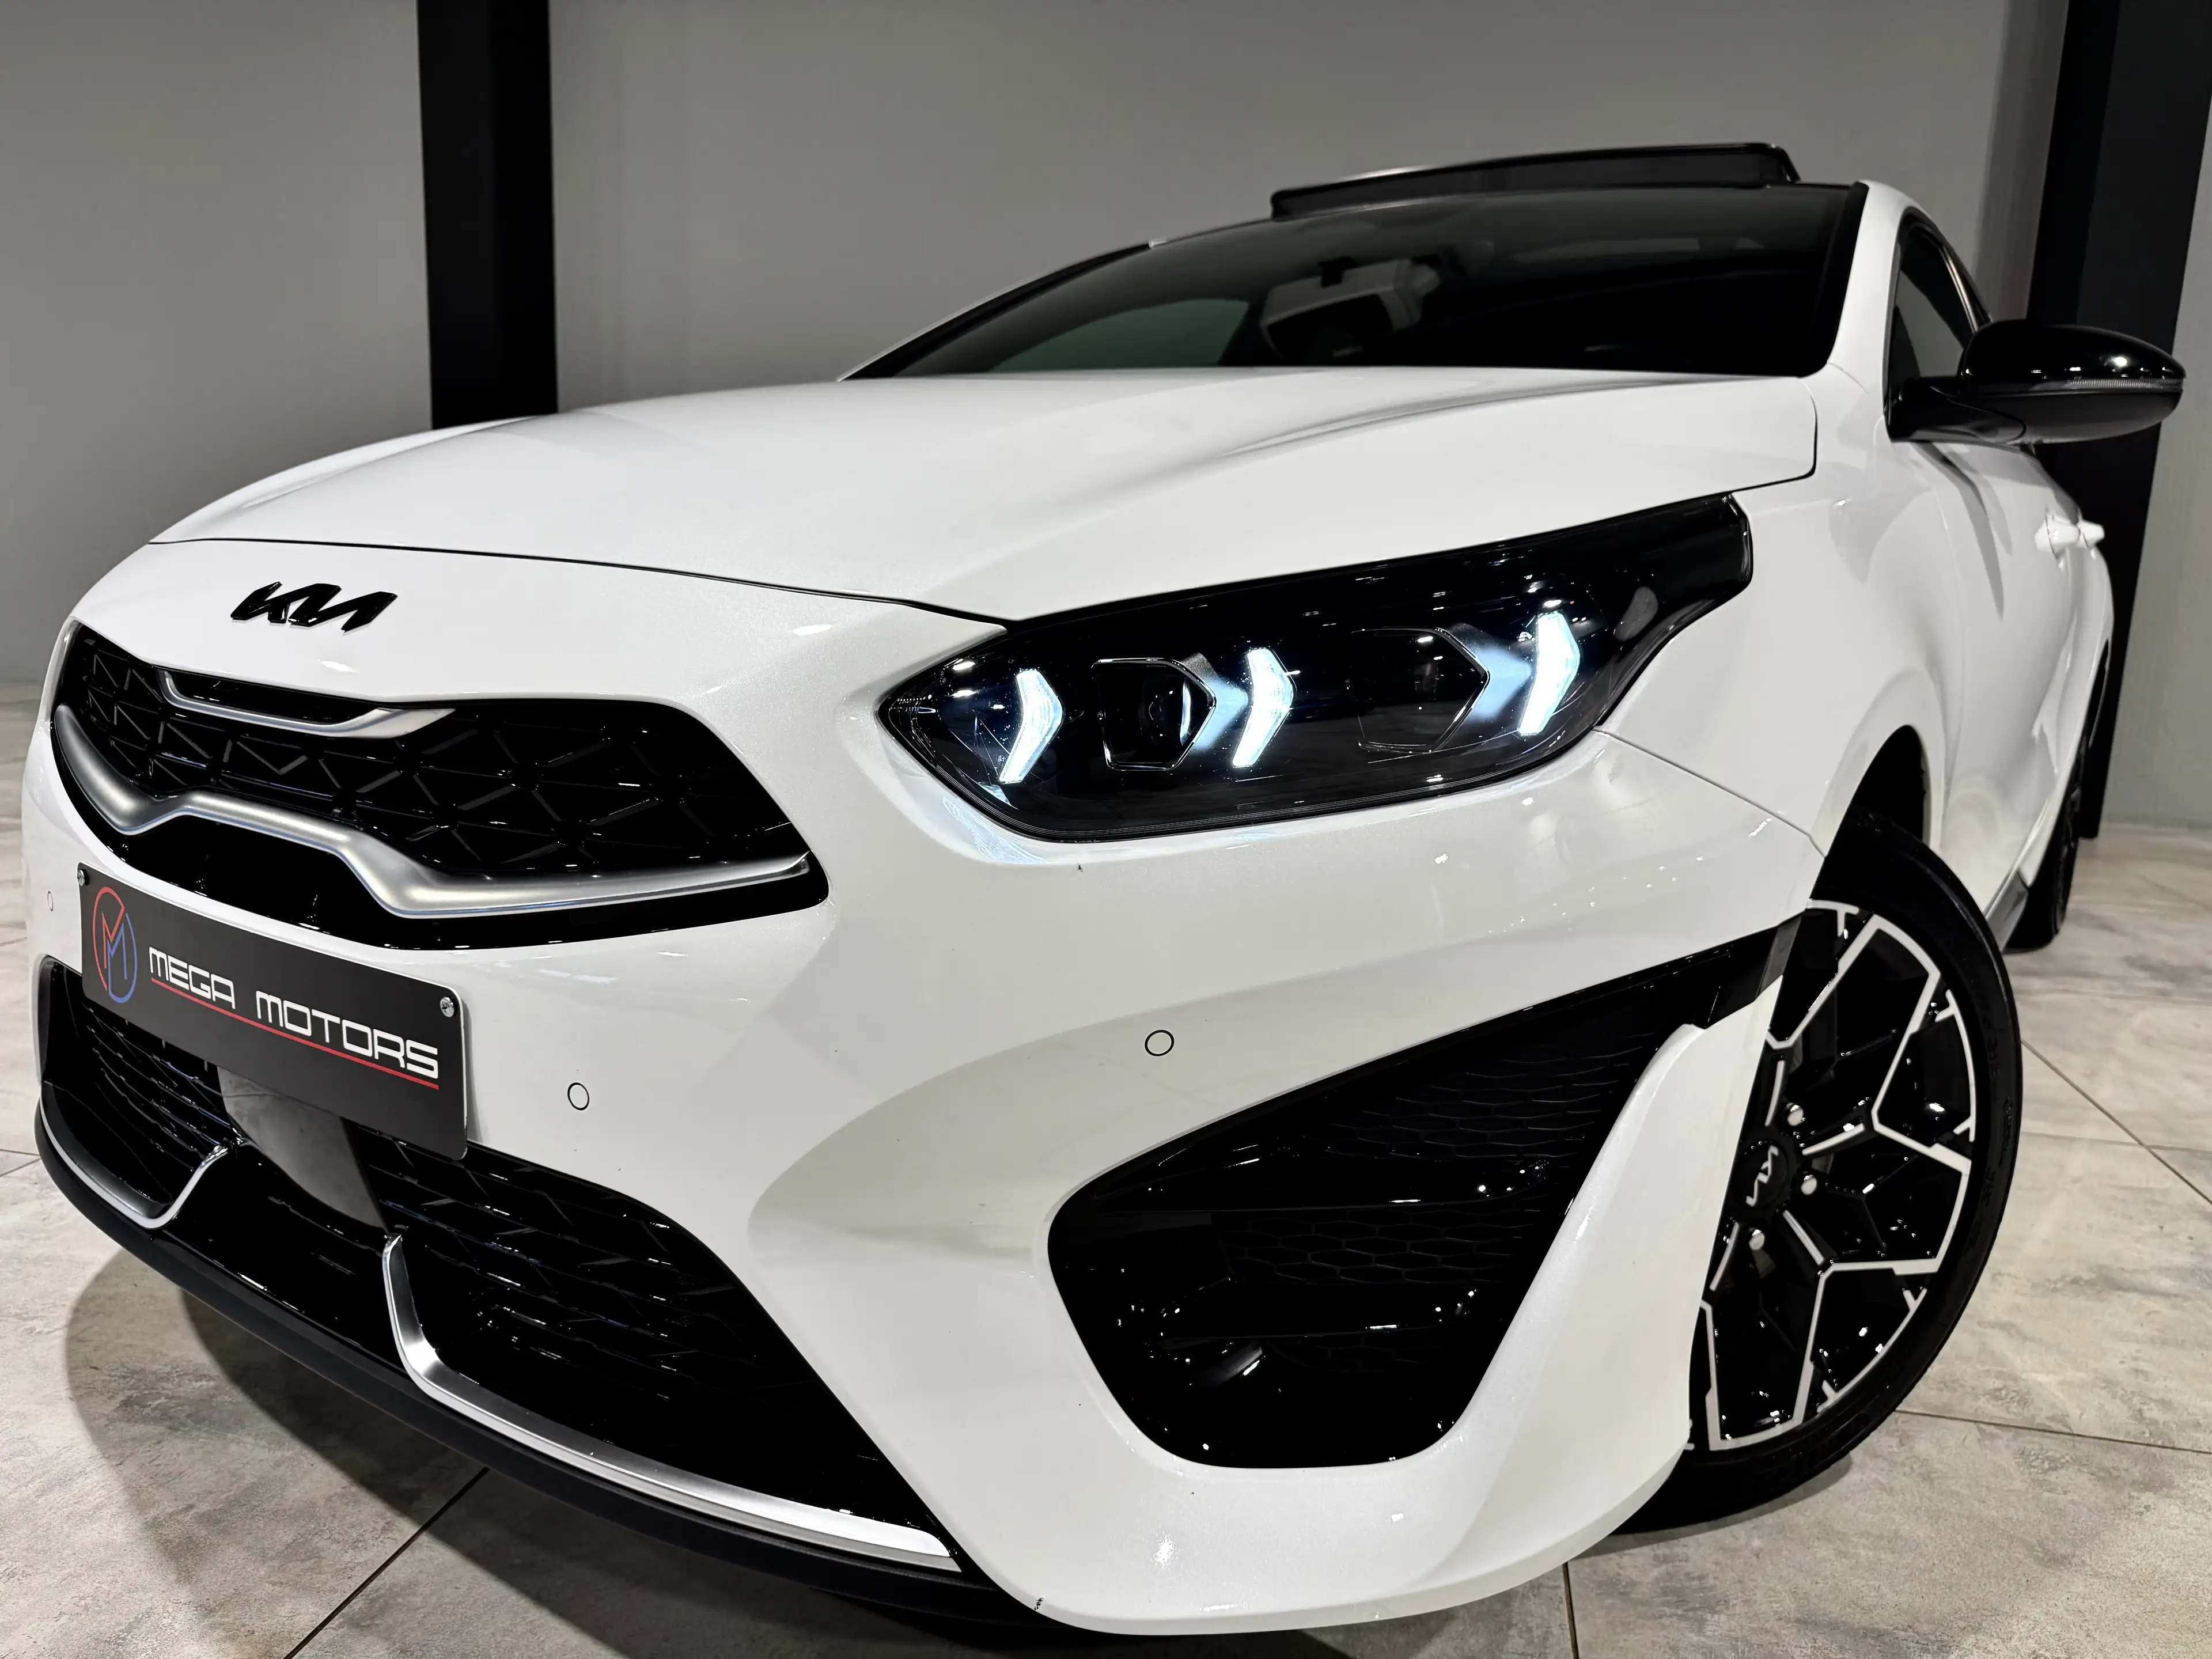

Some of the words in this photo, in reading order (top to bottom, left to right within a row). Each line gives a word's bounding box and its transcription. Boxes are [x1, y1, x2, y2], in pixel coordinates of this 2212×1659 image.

[230, 581, 398, 632] KIA
[149, 946, 236, 1009] MEGA
[256, 990, 438, 1079] MOTORS
